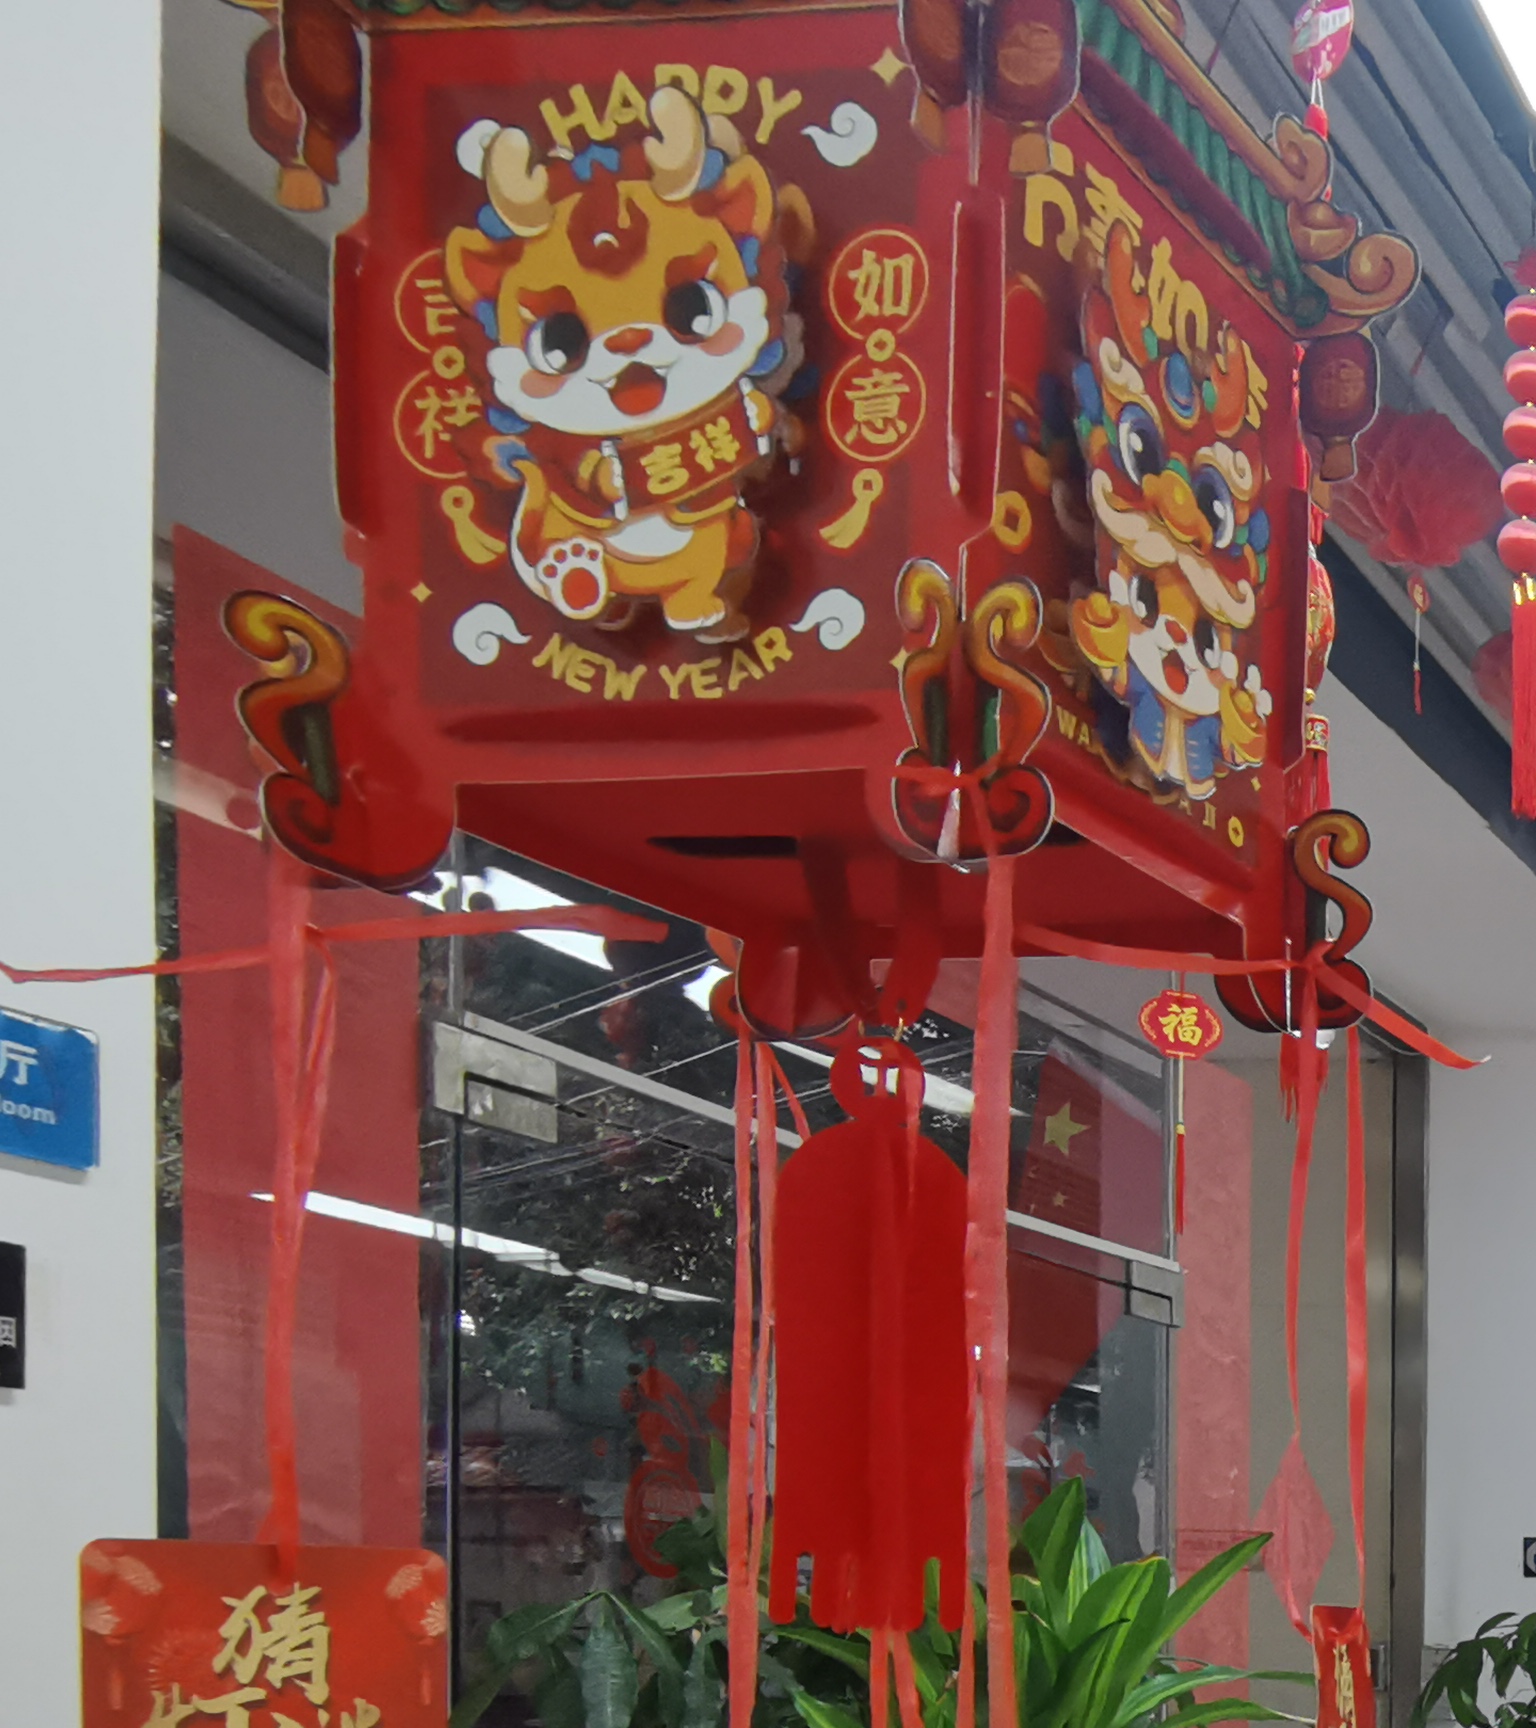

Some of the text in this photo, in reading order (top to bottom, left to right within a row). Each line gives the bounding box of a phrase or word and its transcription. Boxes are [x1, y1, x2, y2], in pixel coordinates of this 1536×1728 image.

[539, 63, 802, 143] HAPPY
[844, 249, 914, 444] 如意
[640, 417, 741, 495] 吉祥
[532, 626, 793, 700] NEW YEAR
[1158, 1003, 1204, 1046] 福
[0, 1094, 57, 1126] oom
